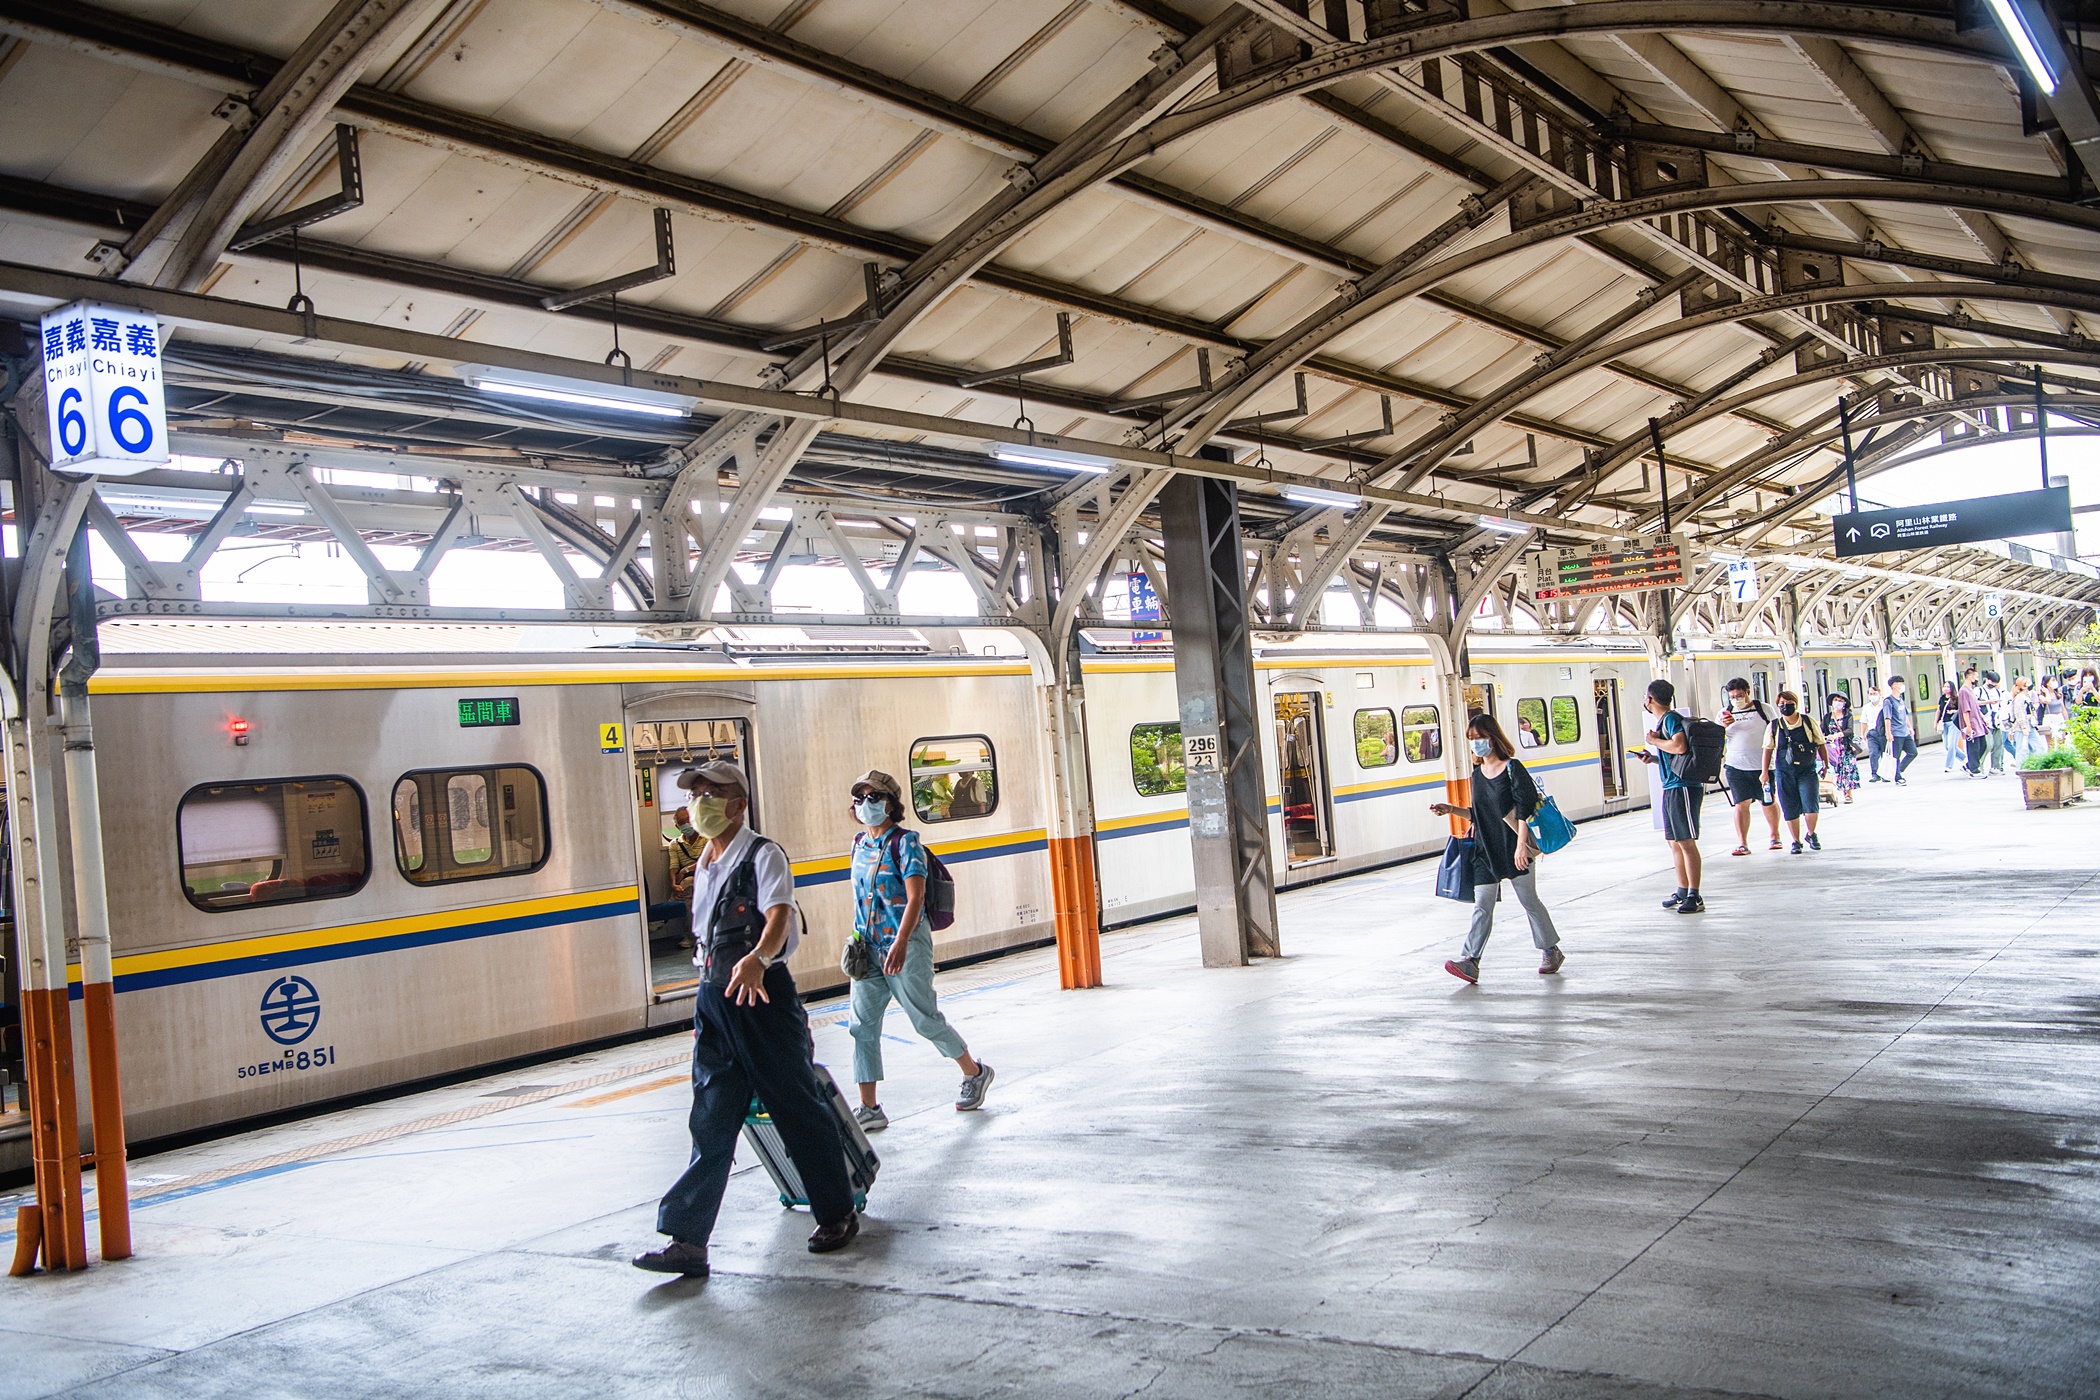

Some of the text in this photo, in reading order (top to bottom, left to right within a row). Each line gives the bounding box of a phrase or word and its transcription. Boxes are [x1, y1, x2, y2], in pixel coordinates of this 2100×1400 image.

[44, 318, 86, 362] 嘉義
[90, 317, 157, 358] 嘉義
[47, 358, 87, 383] Chiayi
[92, 359, 156, 382] Chiayi
[58, 387, 86, 456] 6
[108, 386, 153, 454] 6
[1534, 554, 1541, 568] 1
[1537, 568, 1552, 576] 月台
[1538, 589, 1558, 599] 16:15
[1734, 580, 1746, 599] 7
[1988, 604, 1998, 616] 8
[1326, 692, 1332, 704] 5
[458, 700, 512, 724] 區間車
[606, 726, 618, 745] 4
[1188, 737, 1215, 752] 296
